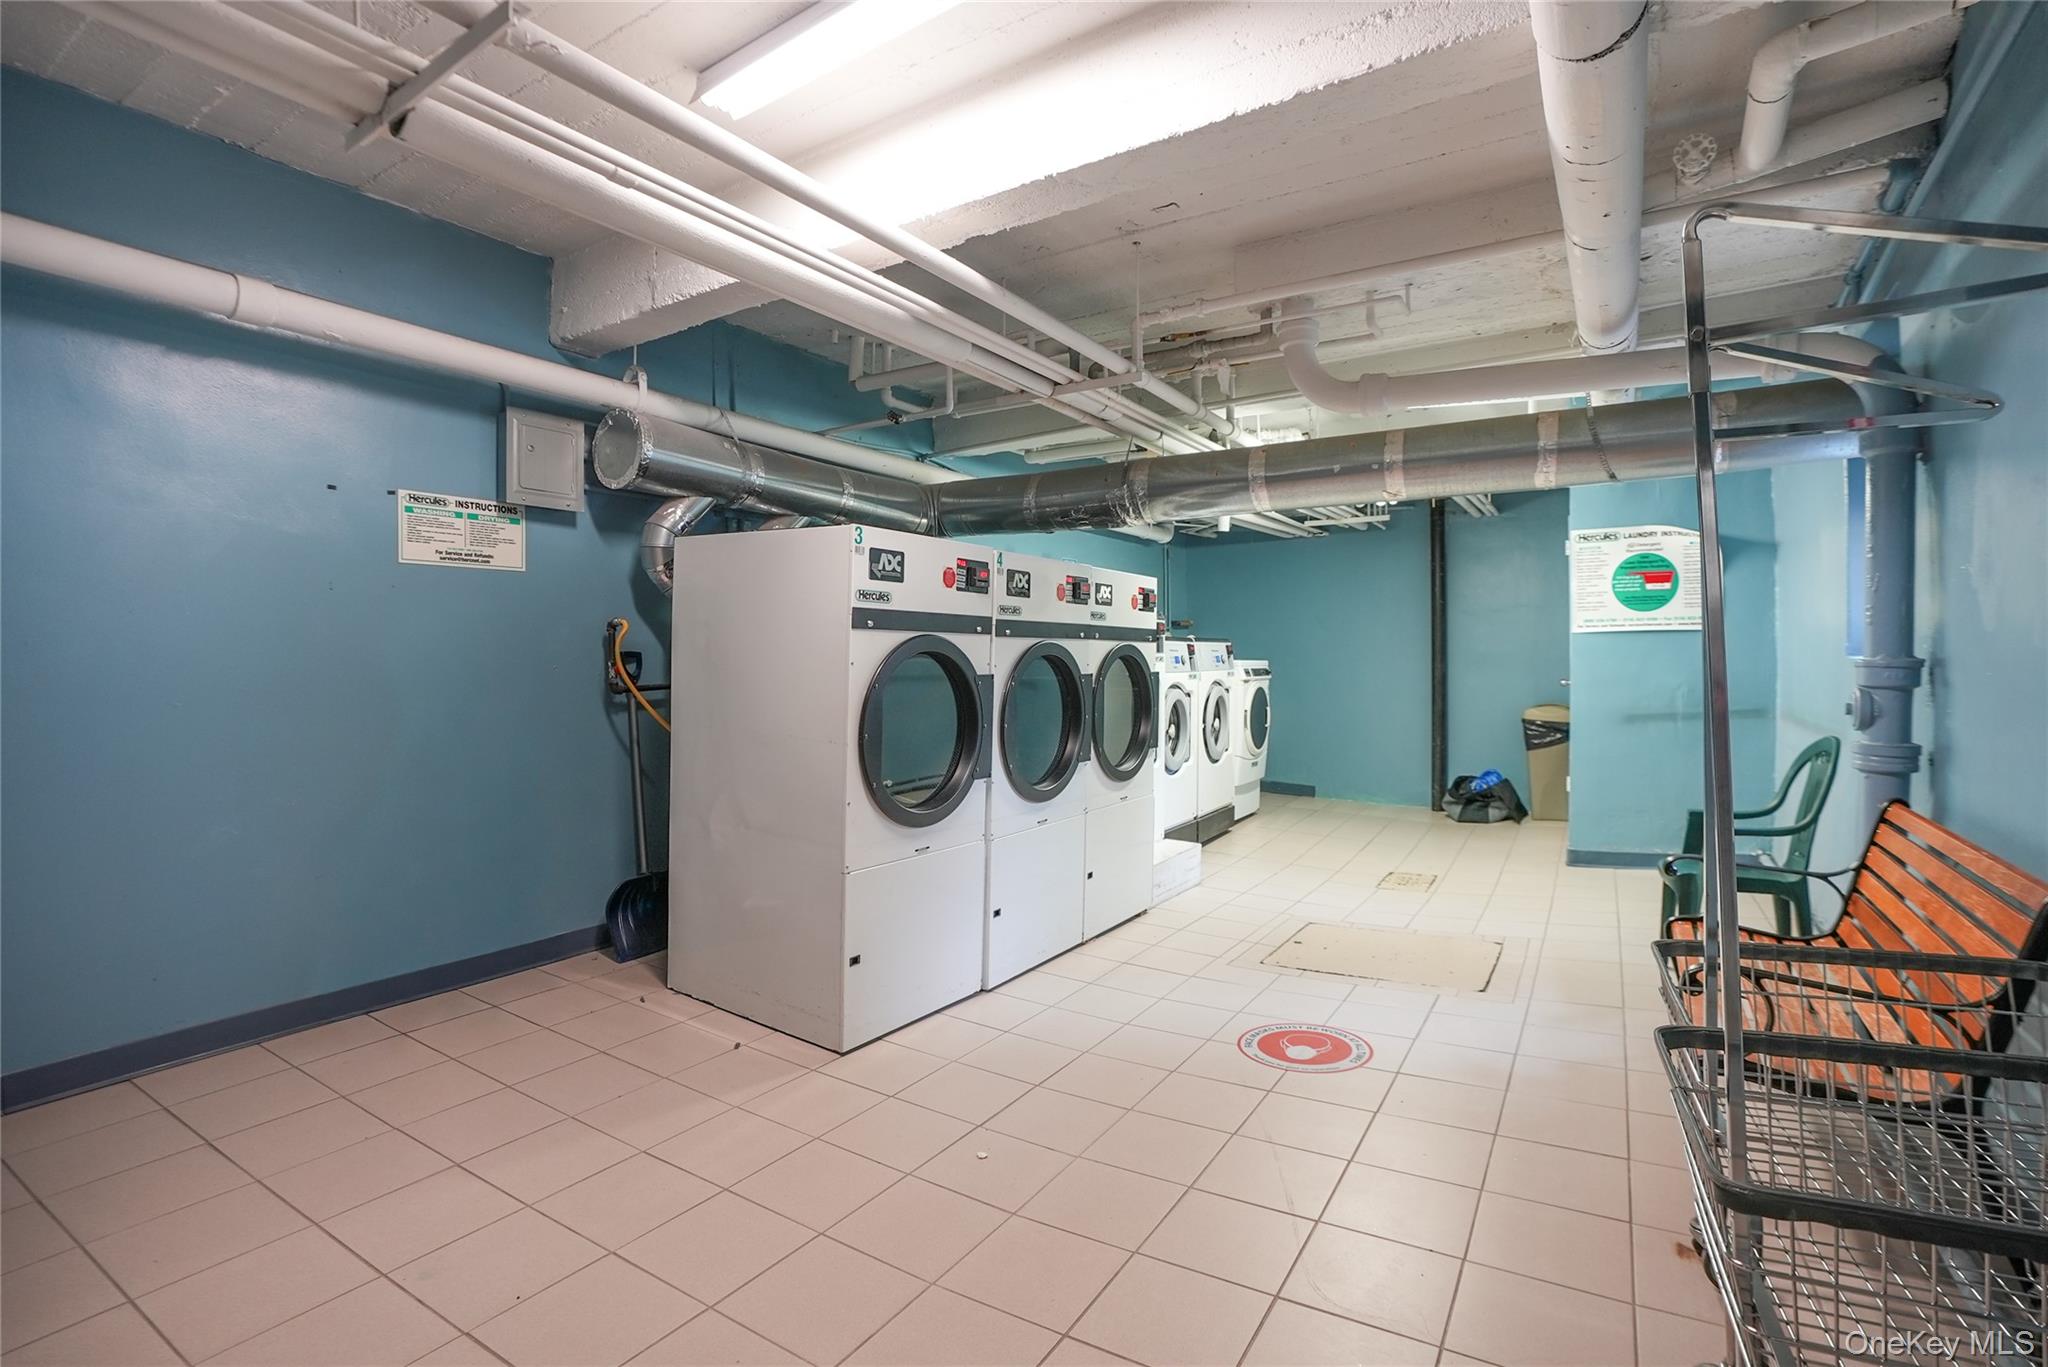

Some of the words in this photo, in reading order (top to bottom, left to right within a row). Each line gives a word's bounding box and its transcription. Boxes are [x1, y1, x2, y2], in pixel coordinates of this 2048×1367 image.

[408, 494, 448, 507] Hercules
[455, 500, 518, 515] INSTRUCTIONS
[413, 506, 456, 518] WASHING
[478, 514, 510, 524] DRYING
[854, 526, 863, 544] 3
[1578, 532, 1618, 542] Hercules
[1623, 530, 1658, 539] LAUNDRY
[878, 552, 902, 573] ADC
[997, 552, 1003, 568] 4
[1012, 573, 1029, 589] ADC
[858, 589, 890, 602] Hercules
[1000, 606, 1021, 615] Hercules
